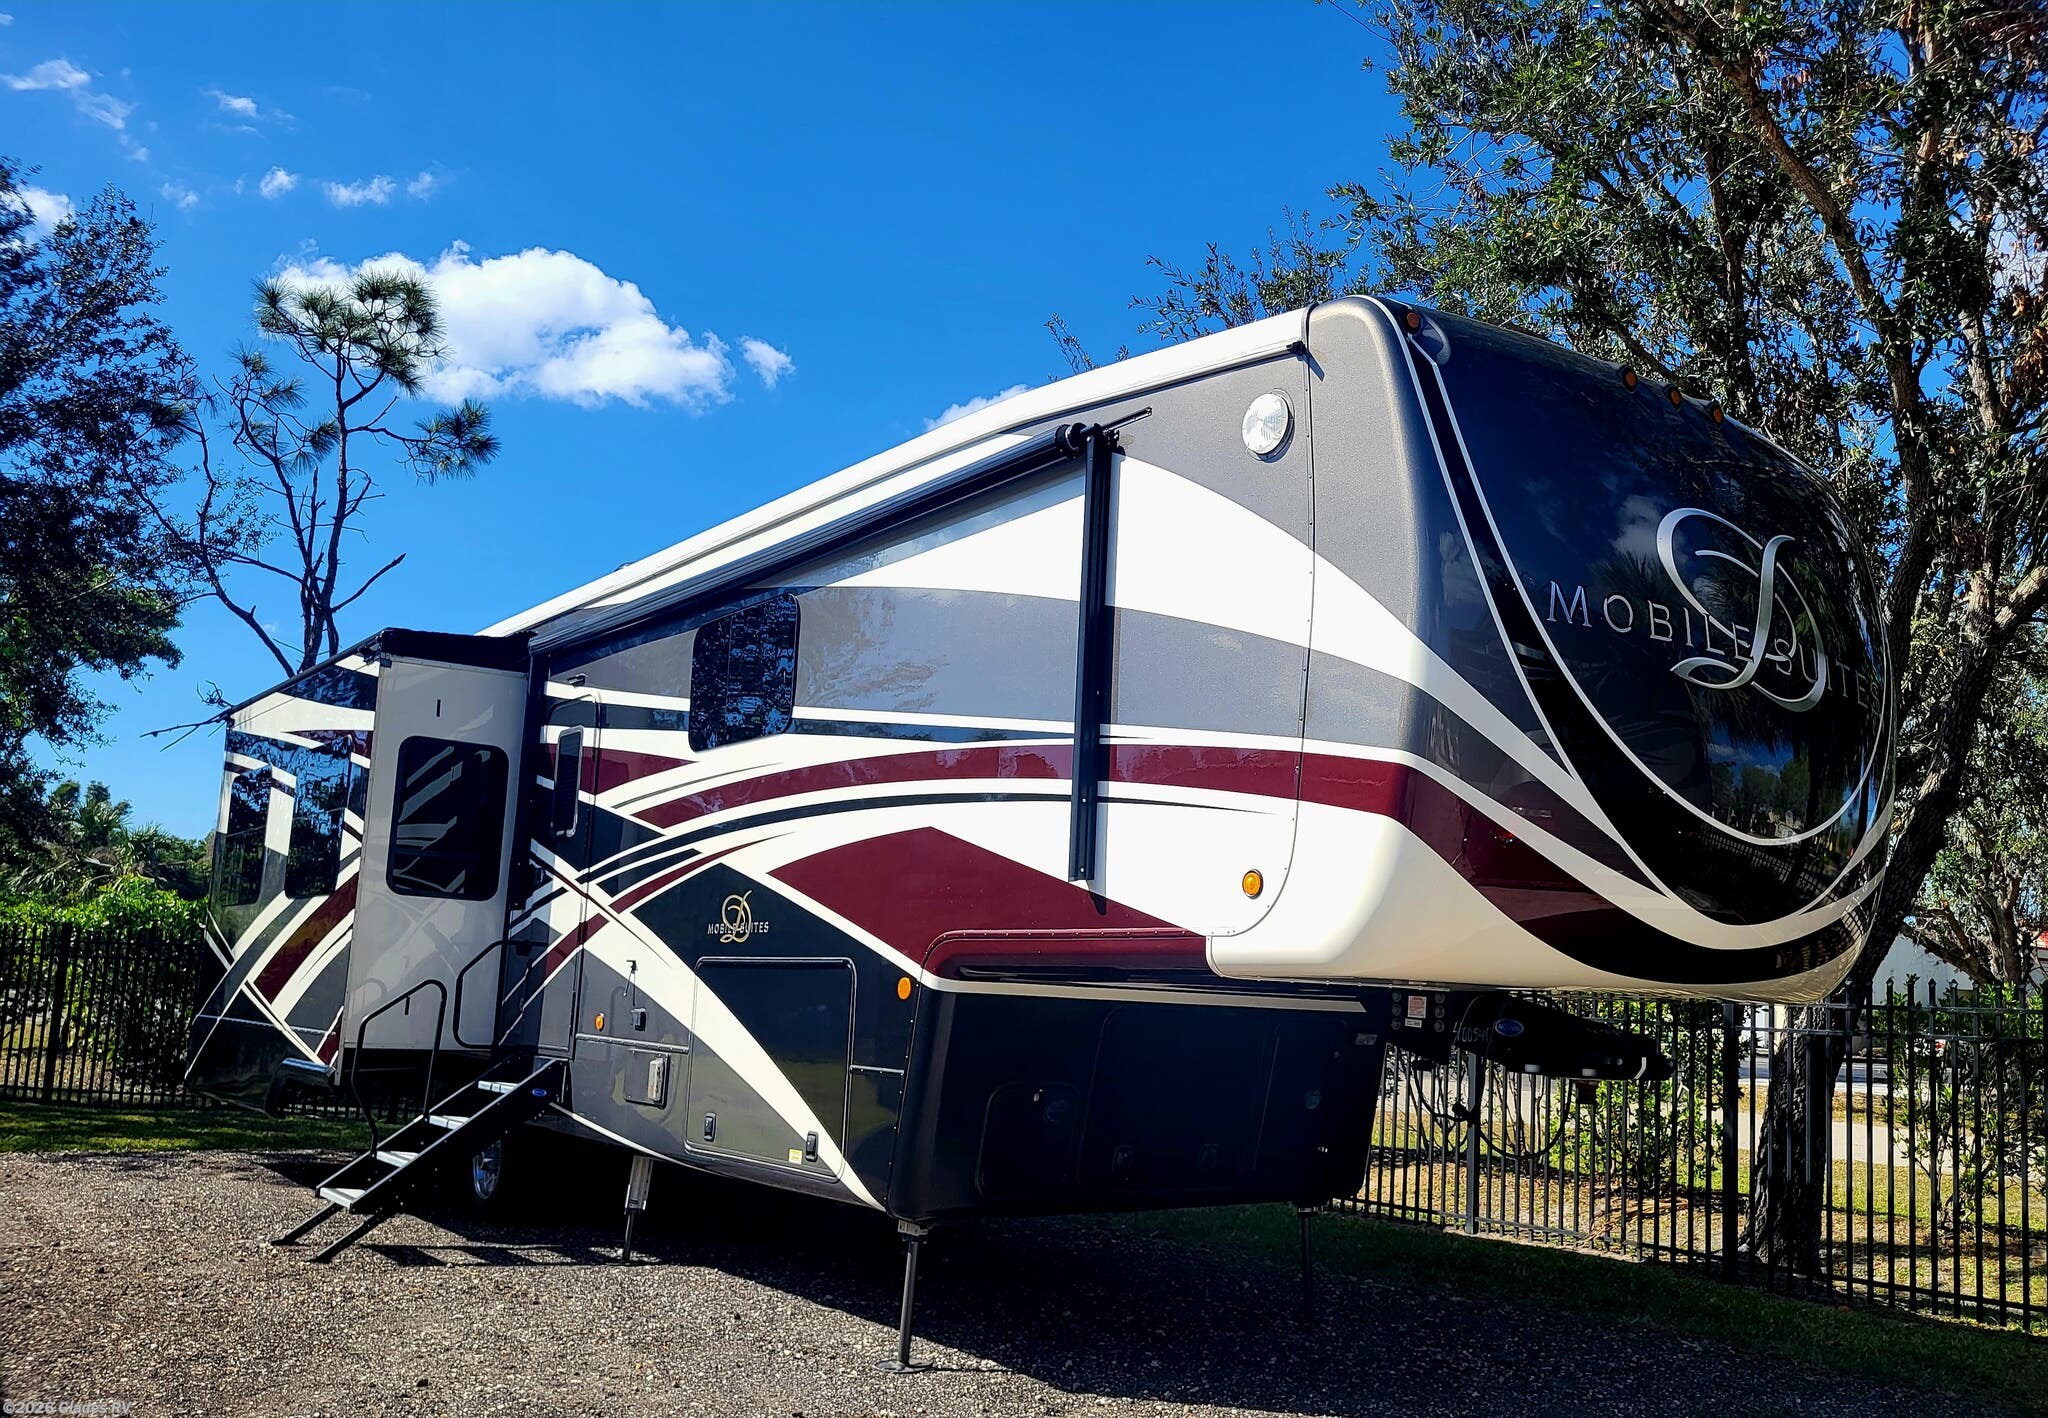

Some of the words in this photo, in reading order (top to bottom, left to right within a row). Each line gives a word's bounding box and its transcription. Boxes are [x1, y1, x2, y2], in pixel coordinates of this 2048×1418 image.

[1546, 581, 1754, 663] MOBILE
[706, 922, 737, 935] MOBILE
[739, 920, 770, 934] SUITES
